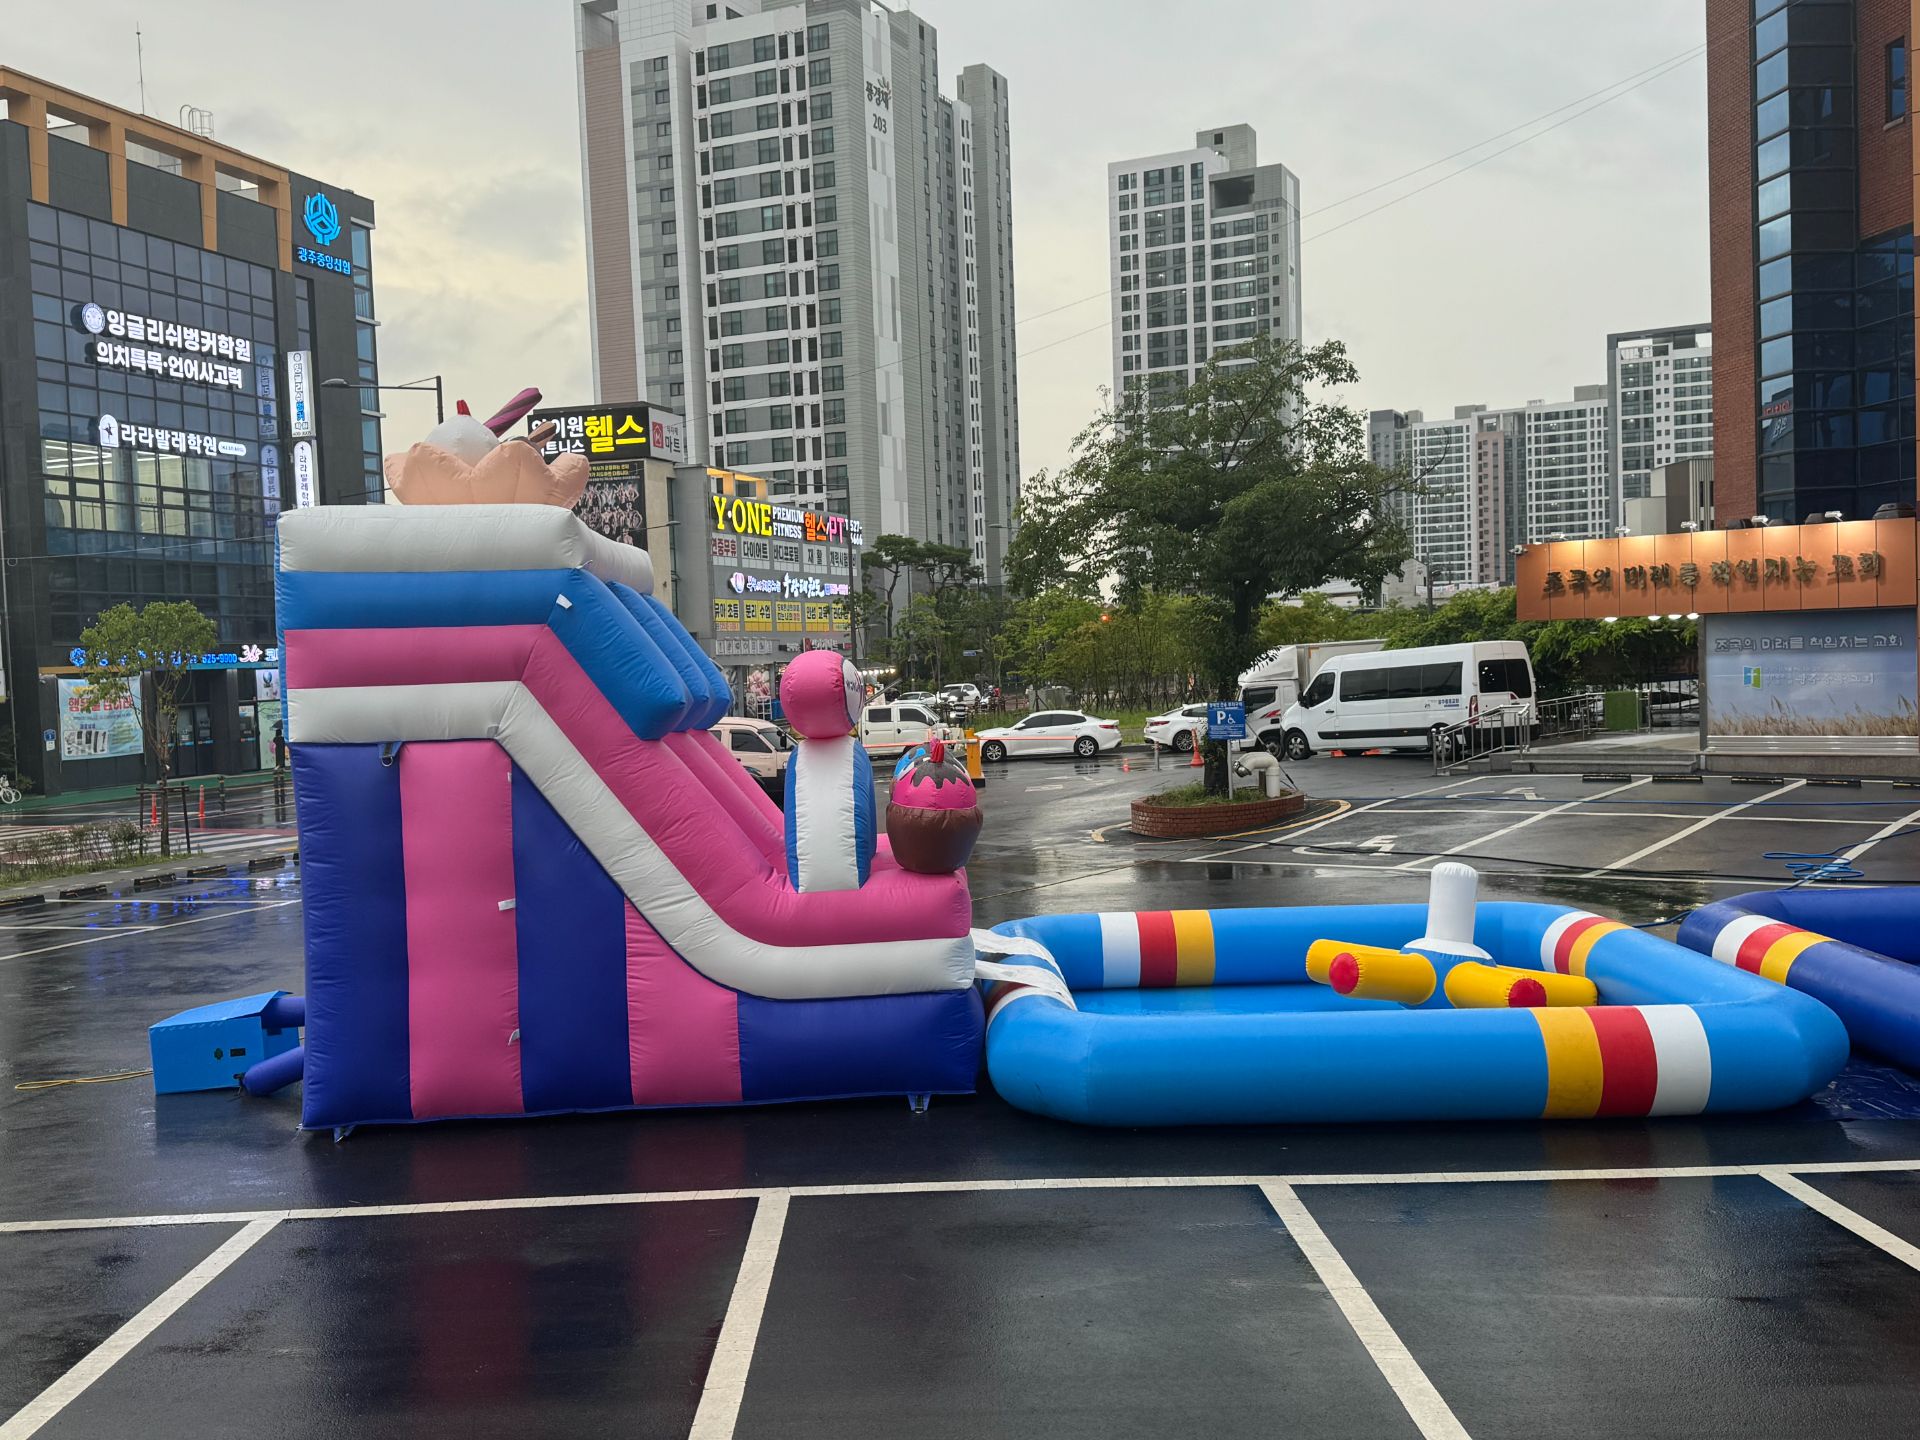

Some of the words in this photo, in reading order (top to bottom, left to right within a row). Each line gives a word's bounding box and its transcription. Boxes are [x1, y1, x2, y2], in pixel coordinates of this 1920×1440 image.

[872, 113, 887, 134] 203
[297, 246, 351, 275] 광주중앙신협
[106, 310, 251, 363] 잉글리쉬벙커학원
[121, 424, 217, 456] 라라발레학원
[584, 415, 646, 453] 헬스
[541, 439, 586, 456] 트니스
[665, 435, 681, 453] 마트
[772, 506, 804, 524] PREMIUM
[773, 522, 802, 539] FITNESS
[712, 537, 737, 557] 연중무휴
[743, 540, 769, 559] 다이어트
[1543, 566, 1612, 593] 조국의
[1715, 637, 1757, 652] 조국의
[1761, 636, 1804, 651] 미래를
[1810, 635, 1868, 649] 책임지는
[1873, 634, 1903, 648] 교회
[202, 653, 238, 664] 625-9900
[1217, 711, 1226, 725] P
